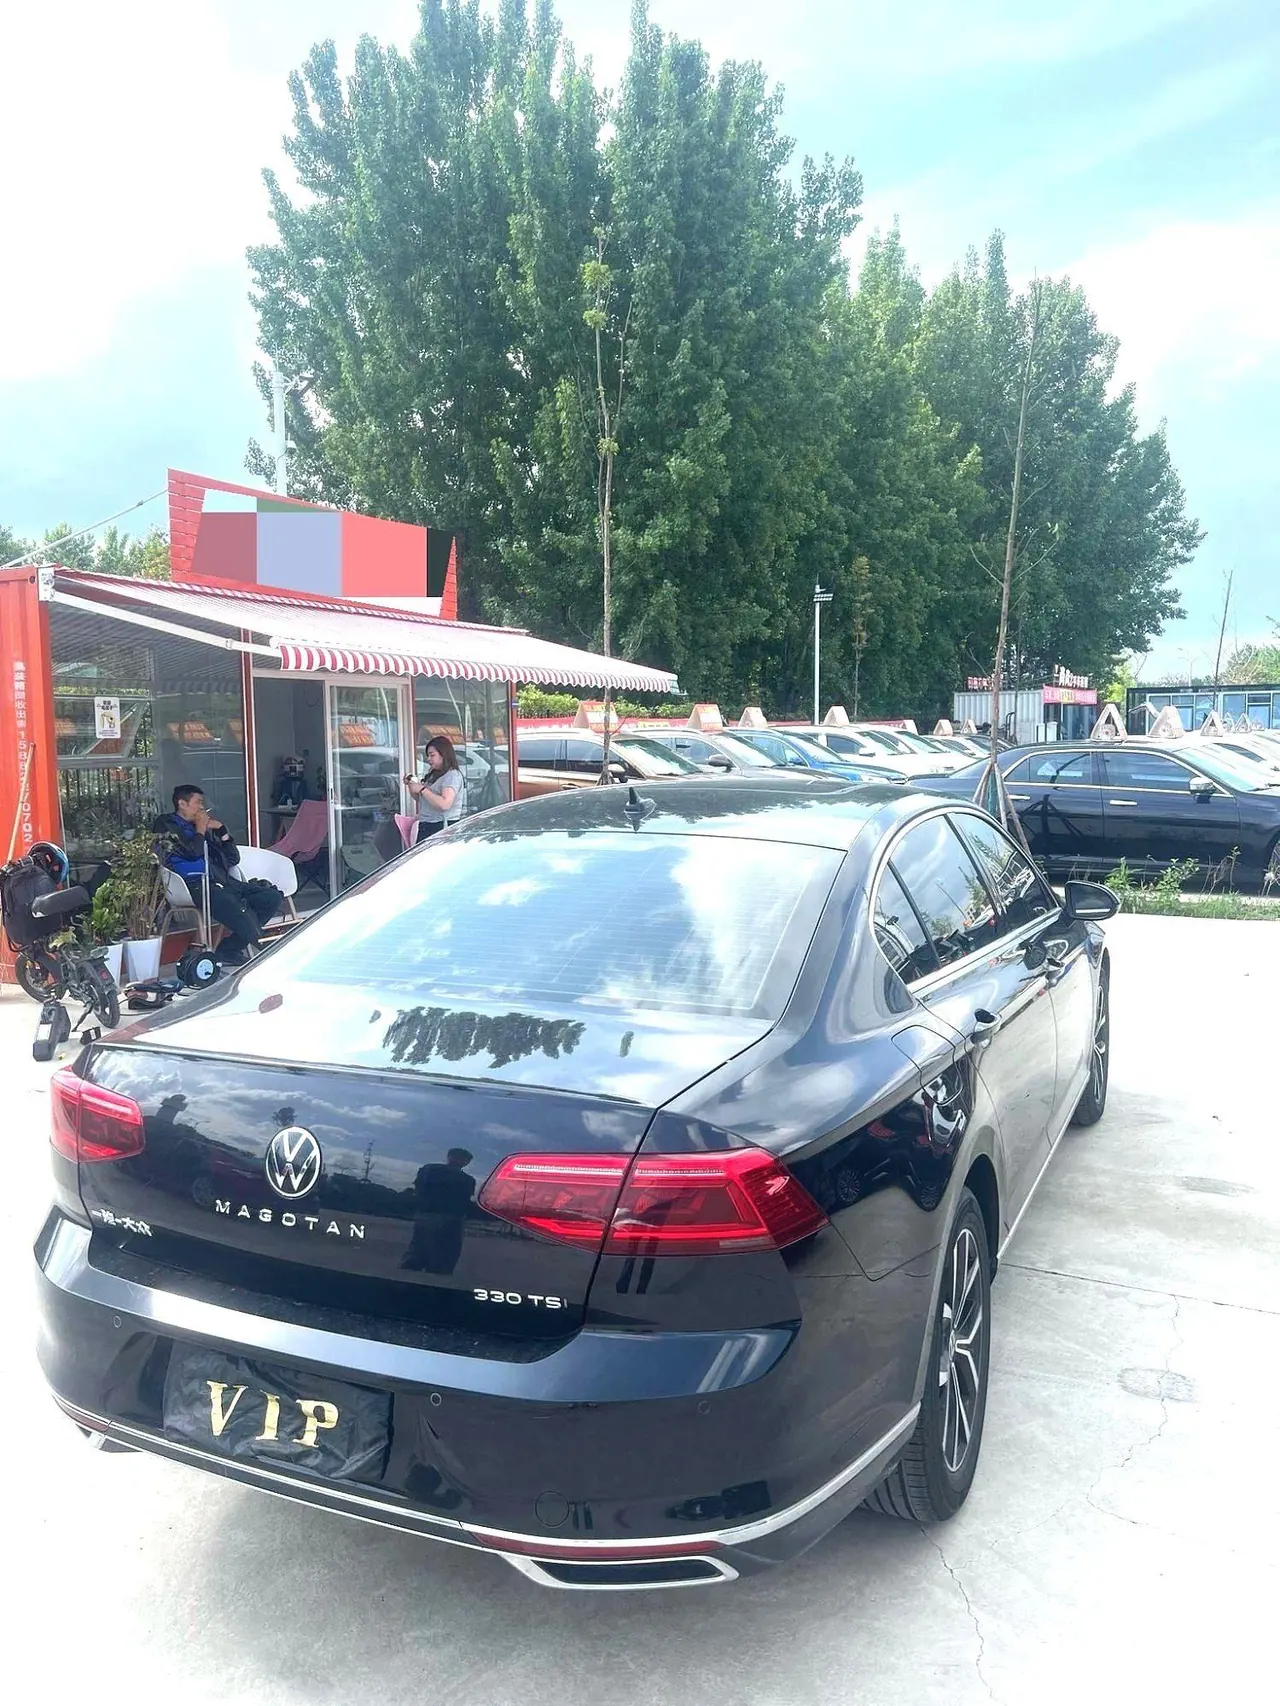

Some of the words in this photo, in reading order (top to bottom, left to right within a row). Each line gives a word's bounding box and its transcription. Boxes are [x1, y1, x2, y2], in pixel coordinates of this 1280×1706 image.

[215, 1199, 365, 1239] MAGOTAN
[473, 1288, 522, 1305] 330
[527, 1294, 568, 1309] TSI
[206, 1380, 339, 1448] VIP
